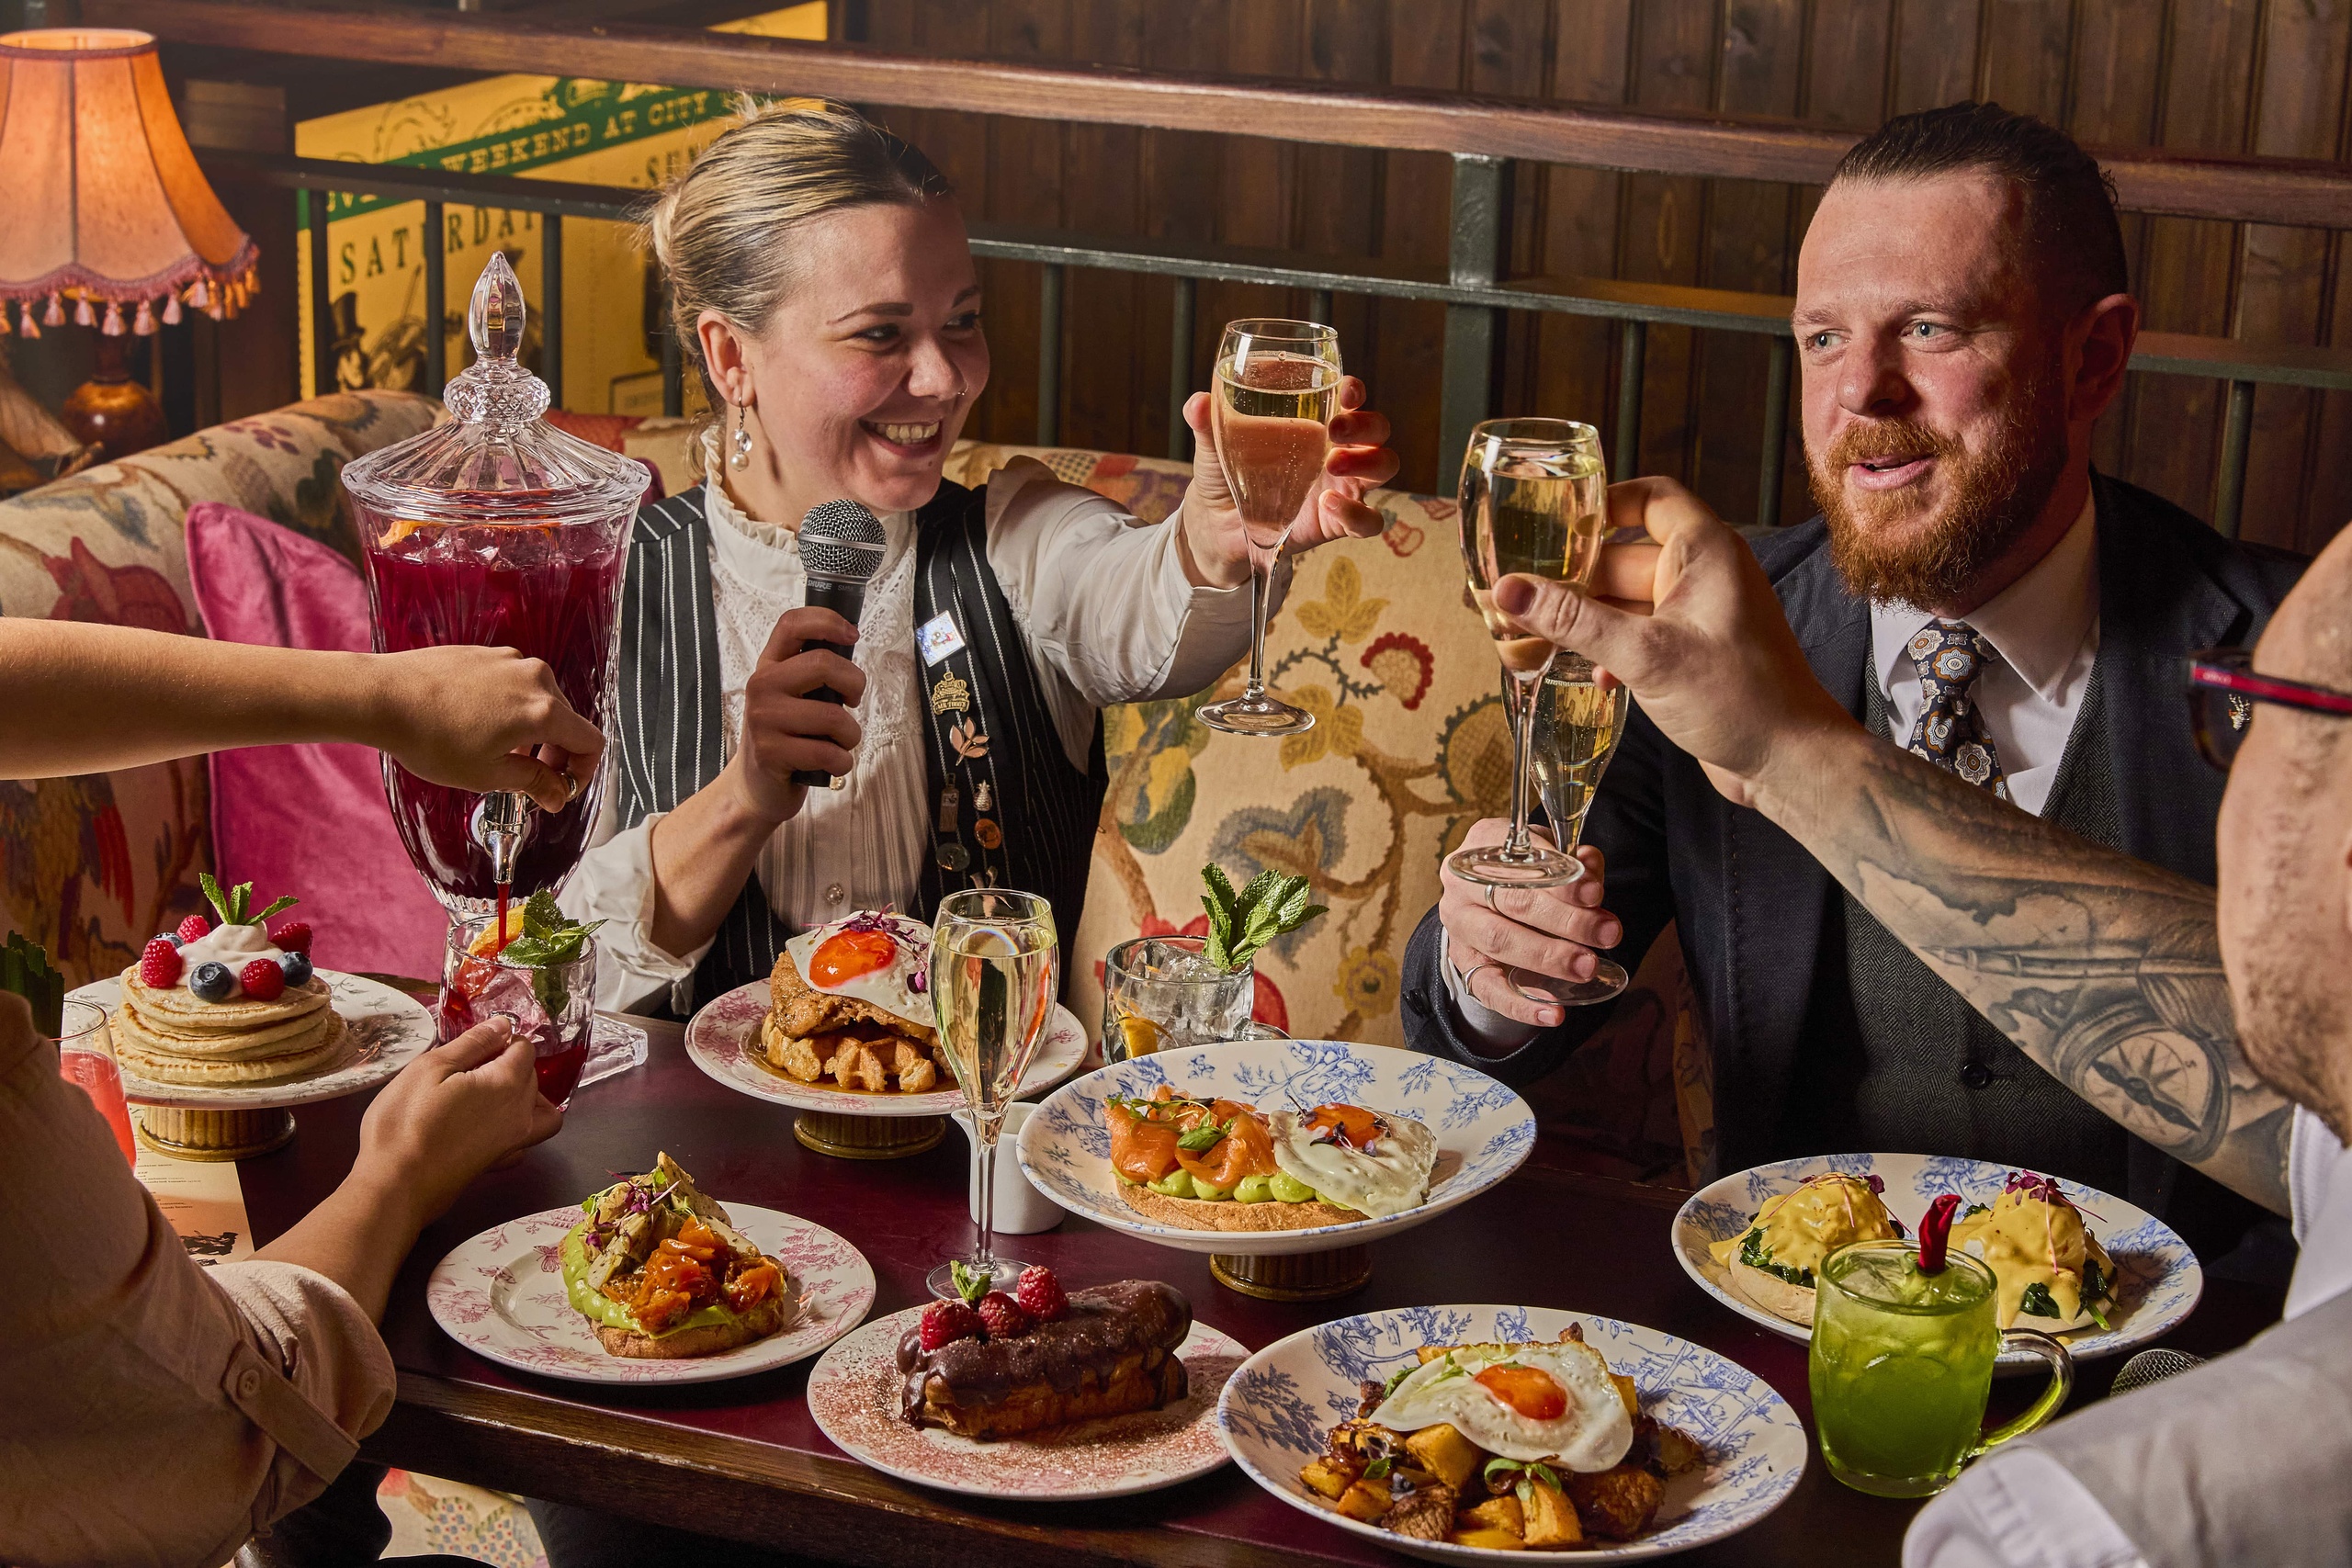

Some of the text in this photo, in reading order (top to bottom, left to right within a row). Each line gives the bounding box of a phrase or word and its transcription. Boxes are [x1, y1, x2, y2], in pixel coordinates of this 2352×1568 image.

[441, 122, 592, 175] WEEKEND
[603, 110, 638, 139] AT
[648, 92, 709, 127] CITY
[341, 208, 535, 285] SATRDA
[808, 580, 832, 590] SHURE
